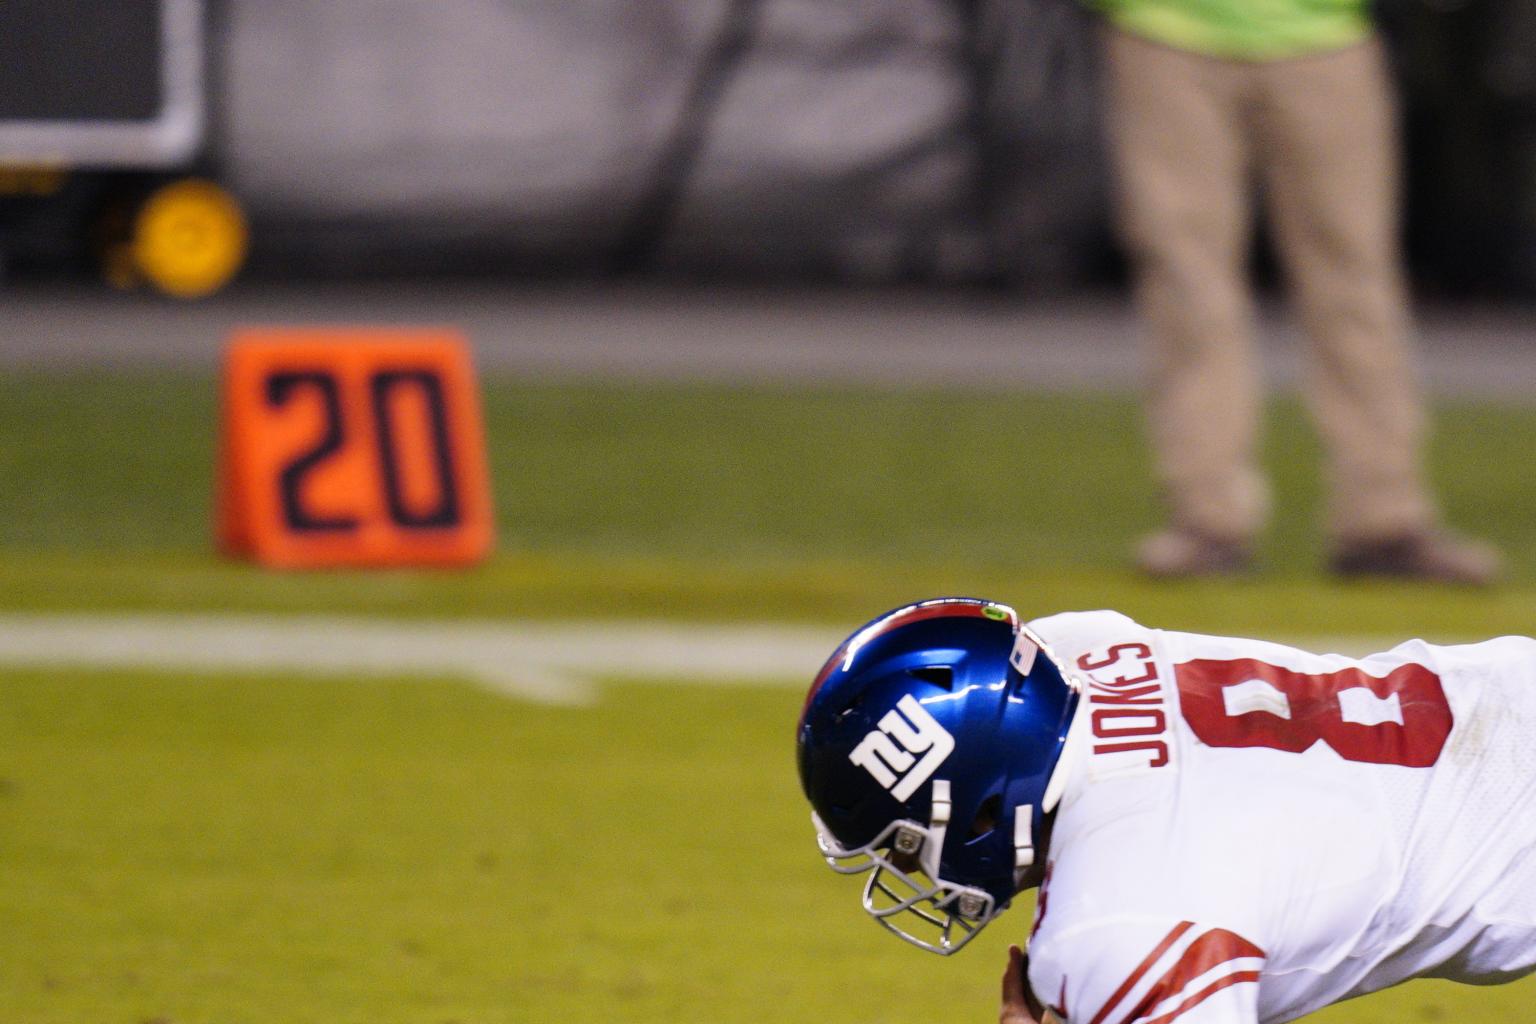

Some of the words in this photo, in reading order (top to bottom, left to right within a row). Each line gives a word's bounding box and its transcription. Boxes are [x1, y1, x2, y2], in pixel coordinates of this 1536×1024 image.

[264, 368, 459, 531] 20
[1077, 643, 1169, 768] JONES
[1174, 658, 1454, 768] 8
